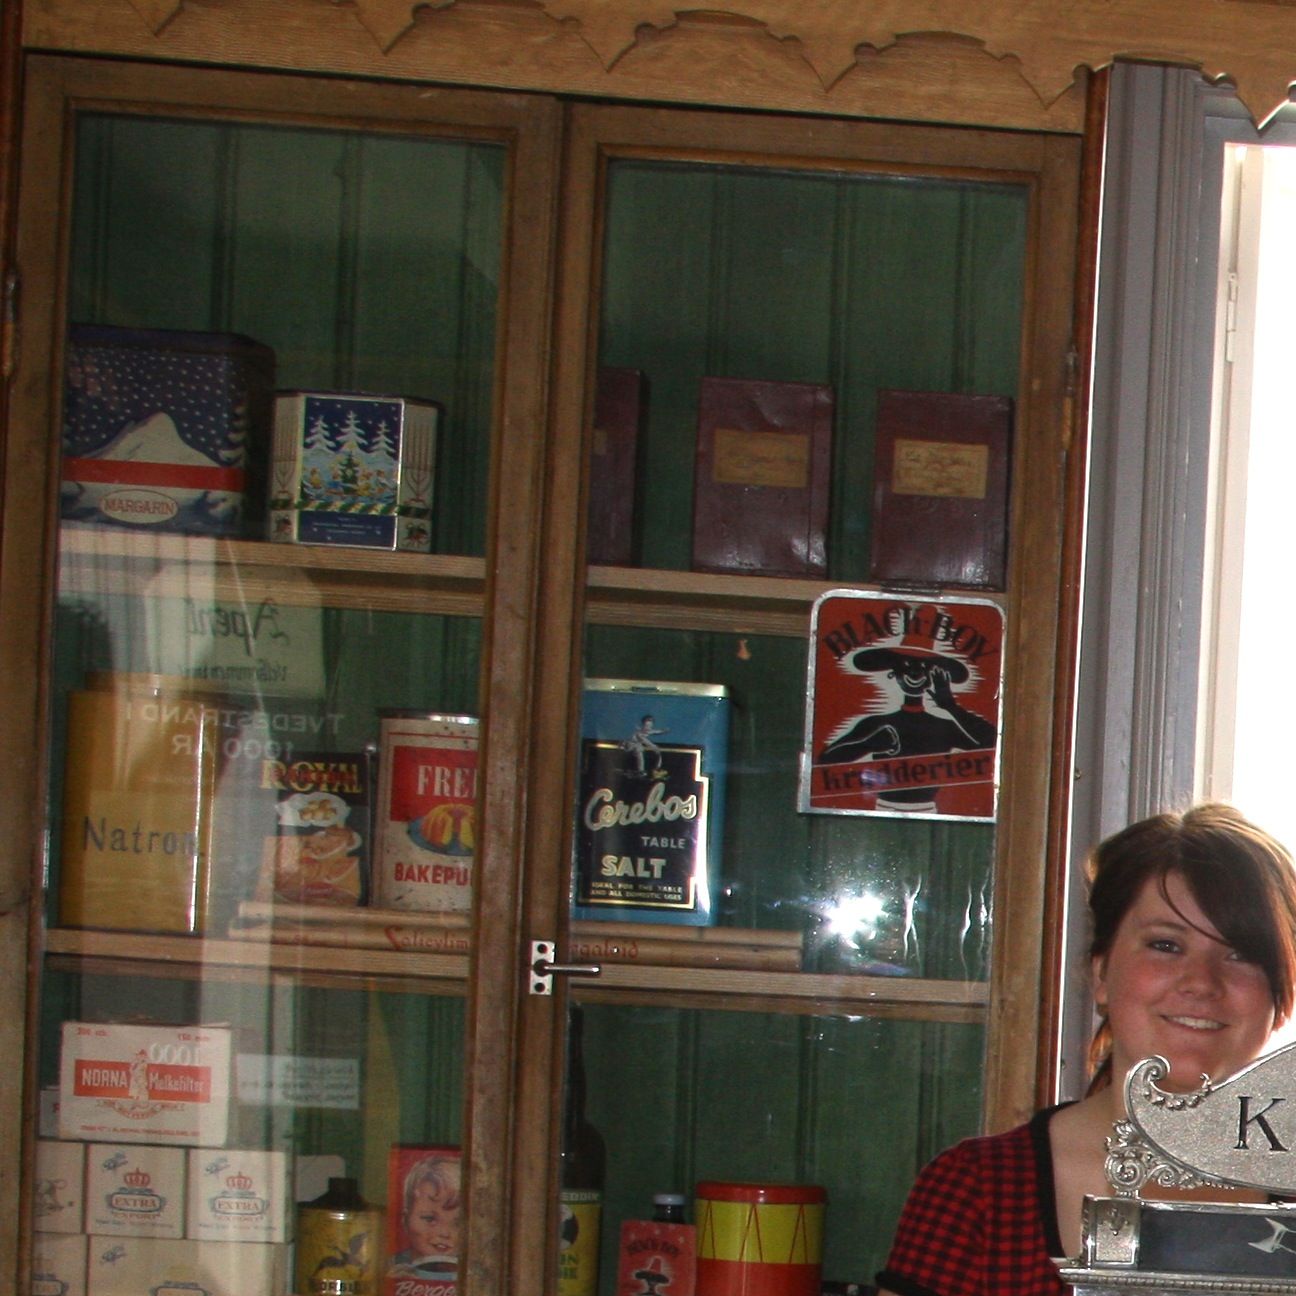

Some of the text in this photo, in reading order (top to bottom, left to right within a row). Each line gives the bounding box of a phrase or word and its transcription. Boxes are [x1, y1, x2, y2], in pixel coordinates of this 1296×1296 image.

[102, 499, 176, 515] MARGARIN
[260, 759, 364, 793] ROYAL
[584, 782, 697, 831] Cerebos
[81, 816, 200, 857] Natron
[641, 836, 686, 849] TABLE
[394, 862, 473, 887] BAKEPU
[600, 854, 667, 879] SALT
[81, 1067, 206, 1093] NORNA Melkefilter
[114, 1197, 158, 1209] EXTRA
[216, 1200, 260, 1212] EXTRA
